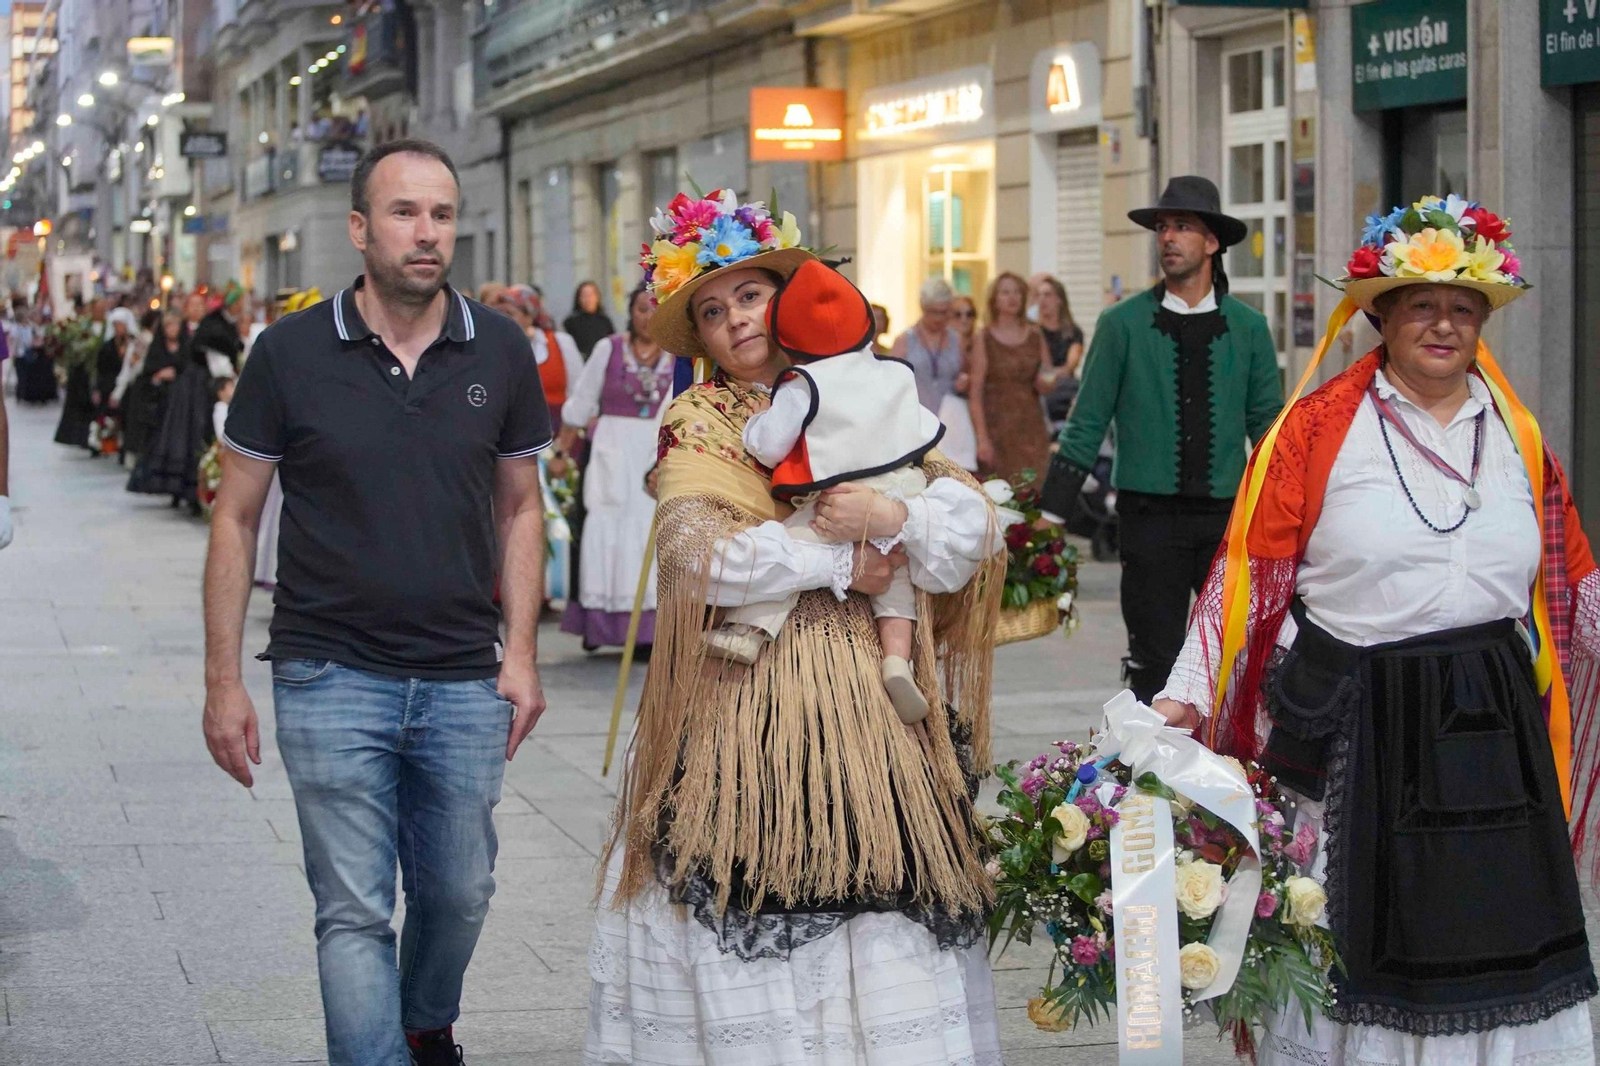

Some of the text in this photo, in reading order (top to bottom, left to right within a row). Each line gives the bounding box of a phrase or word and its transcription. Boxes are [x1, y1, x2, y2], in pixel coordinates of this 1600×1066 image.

[1383, 16, 1449, 53] VISIÓN
[1546, 33, 1558, 54] El
[1560, 31, 1576, 52] fin
[1578, 29, 1594, 49] de
[1355, 64, 1365, 83] El
[1366, 63, 1380, 81] fin
[1380, 62, 1393, 80] de
[1410, 53, 1438, 80] gafas
[1438, 52, 1467, 71] caras
[1123, 905, 1162, 1050] HORACIO
